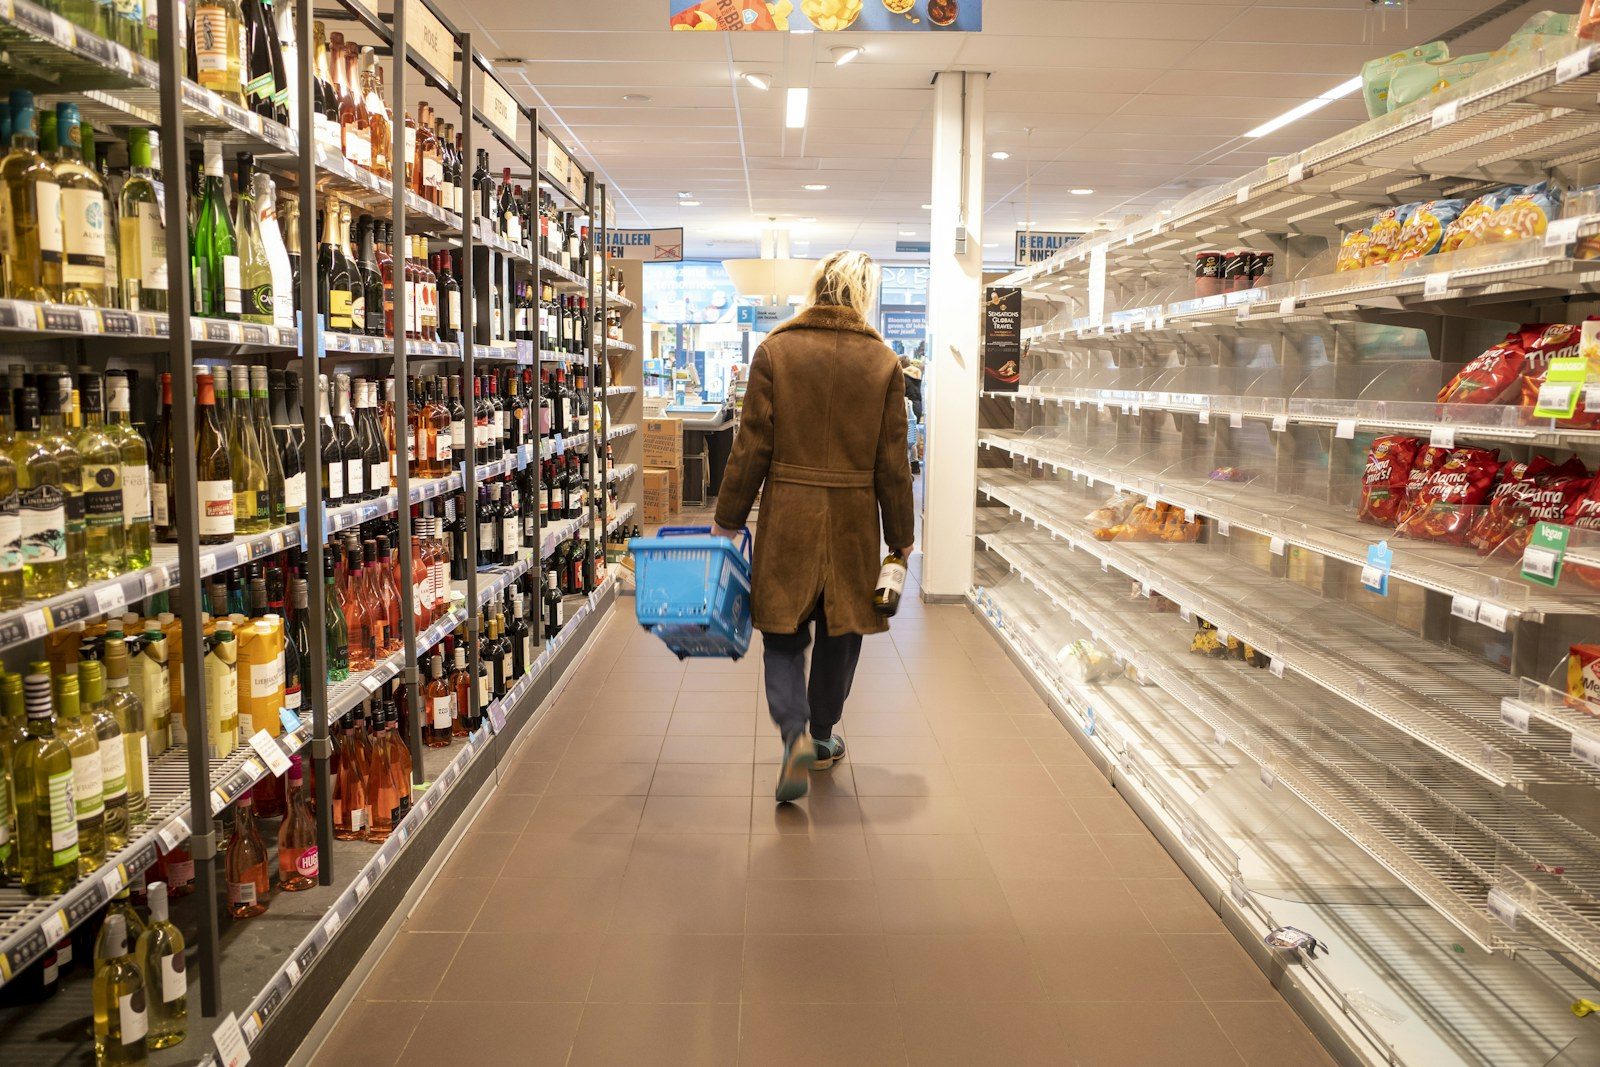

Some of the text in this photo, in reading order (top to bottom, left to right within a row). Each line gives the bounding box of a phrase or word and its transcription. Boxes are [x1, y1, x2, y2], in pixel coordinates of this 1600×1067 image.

[424, 26, 438, 52] ROSÉ
[613, 233, 651, 246] ALLEEN
[1020, 236, 1080, 249] HER ALL
[742, 310, 748, 320] 5
[1542, 525, 1563, 541] Vegan
